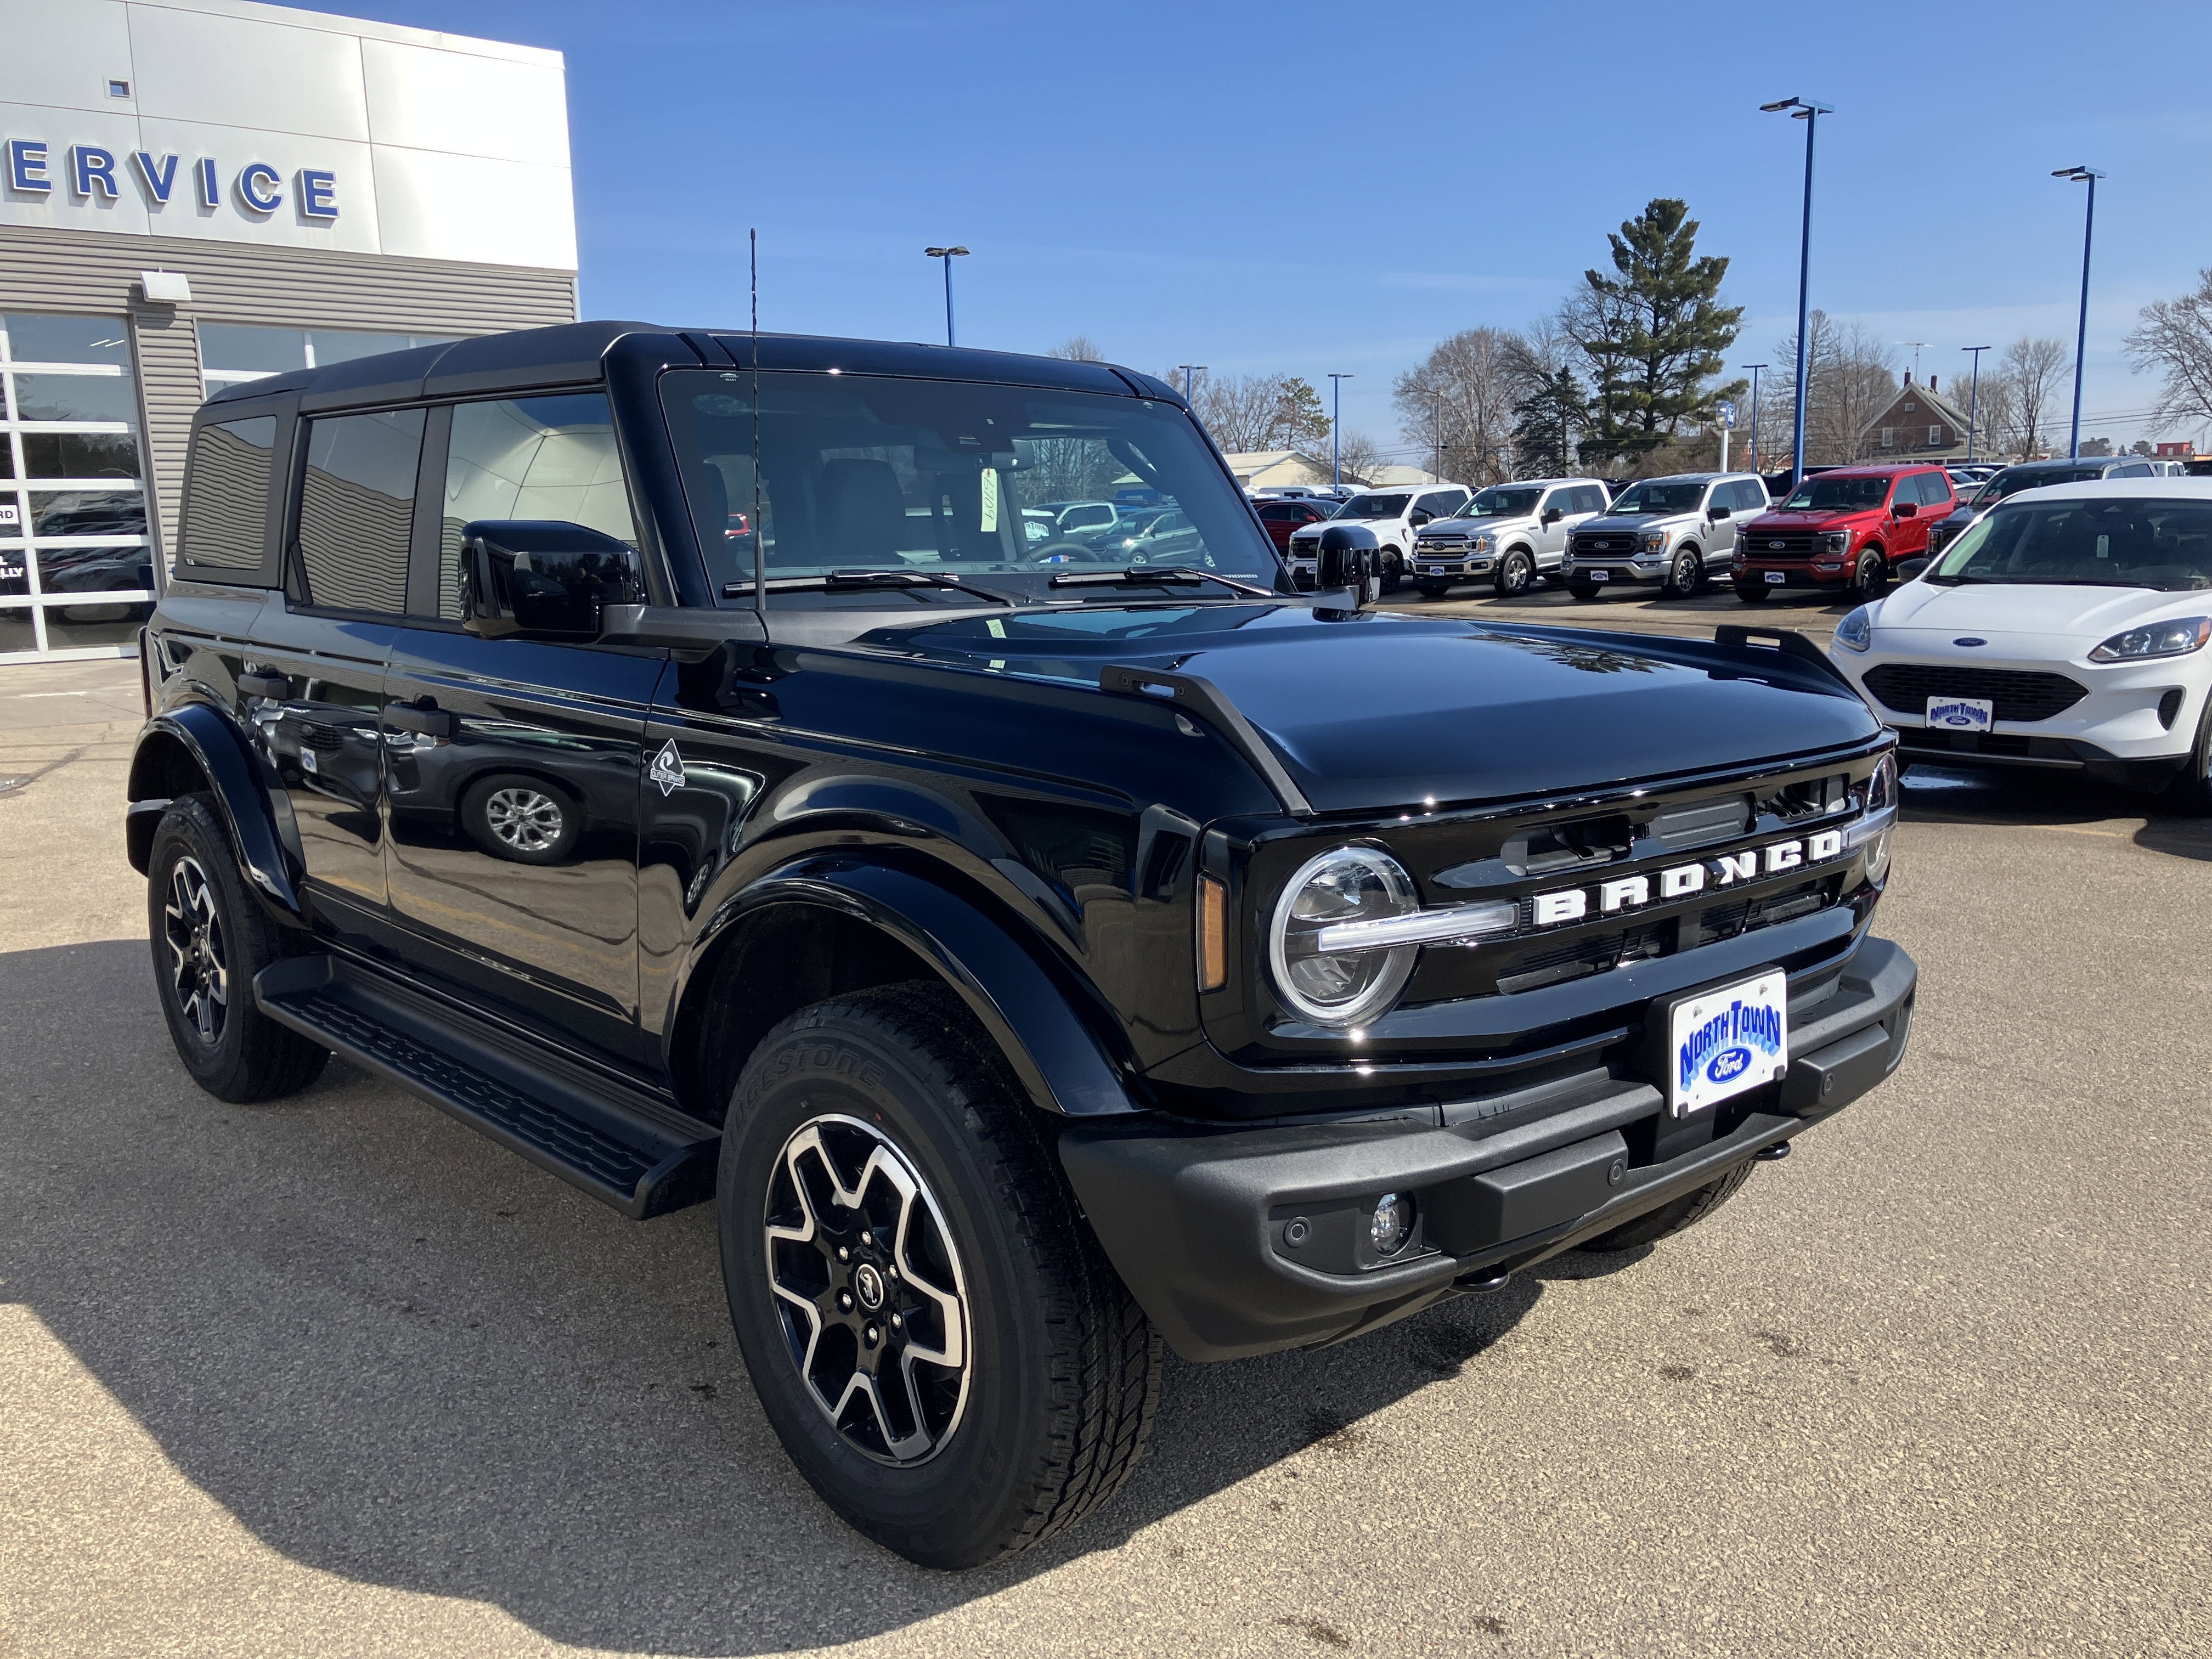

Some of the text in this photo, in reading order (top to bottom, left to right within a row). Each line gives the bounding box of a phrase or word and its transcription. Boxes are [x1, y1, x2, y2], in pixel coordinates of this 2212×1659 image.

[8, 138, 340, 219] ERVICE
[1533, 830, 1841, 924] BRONCO
[1714, 1051, 1743, 1079] Ford
